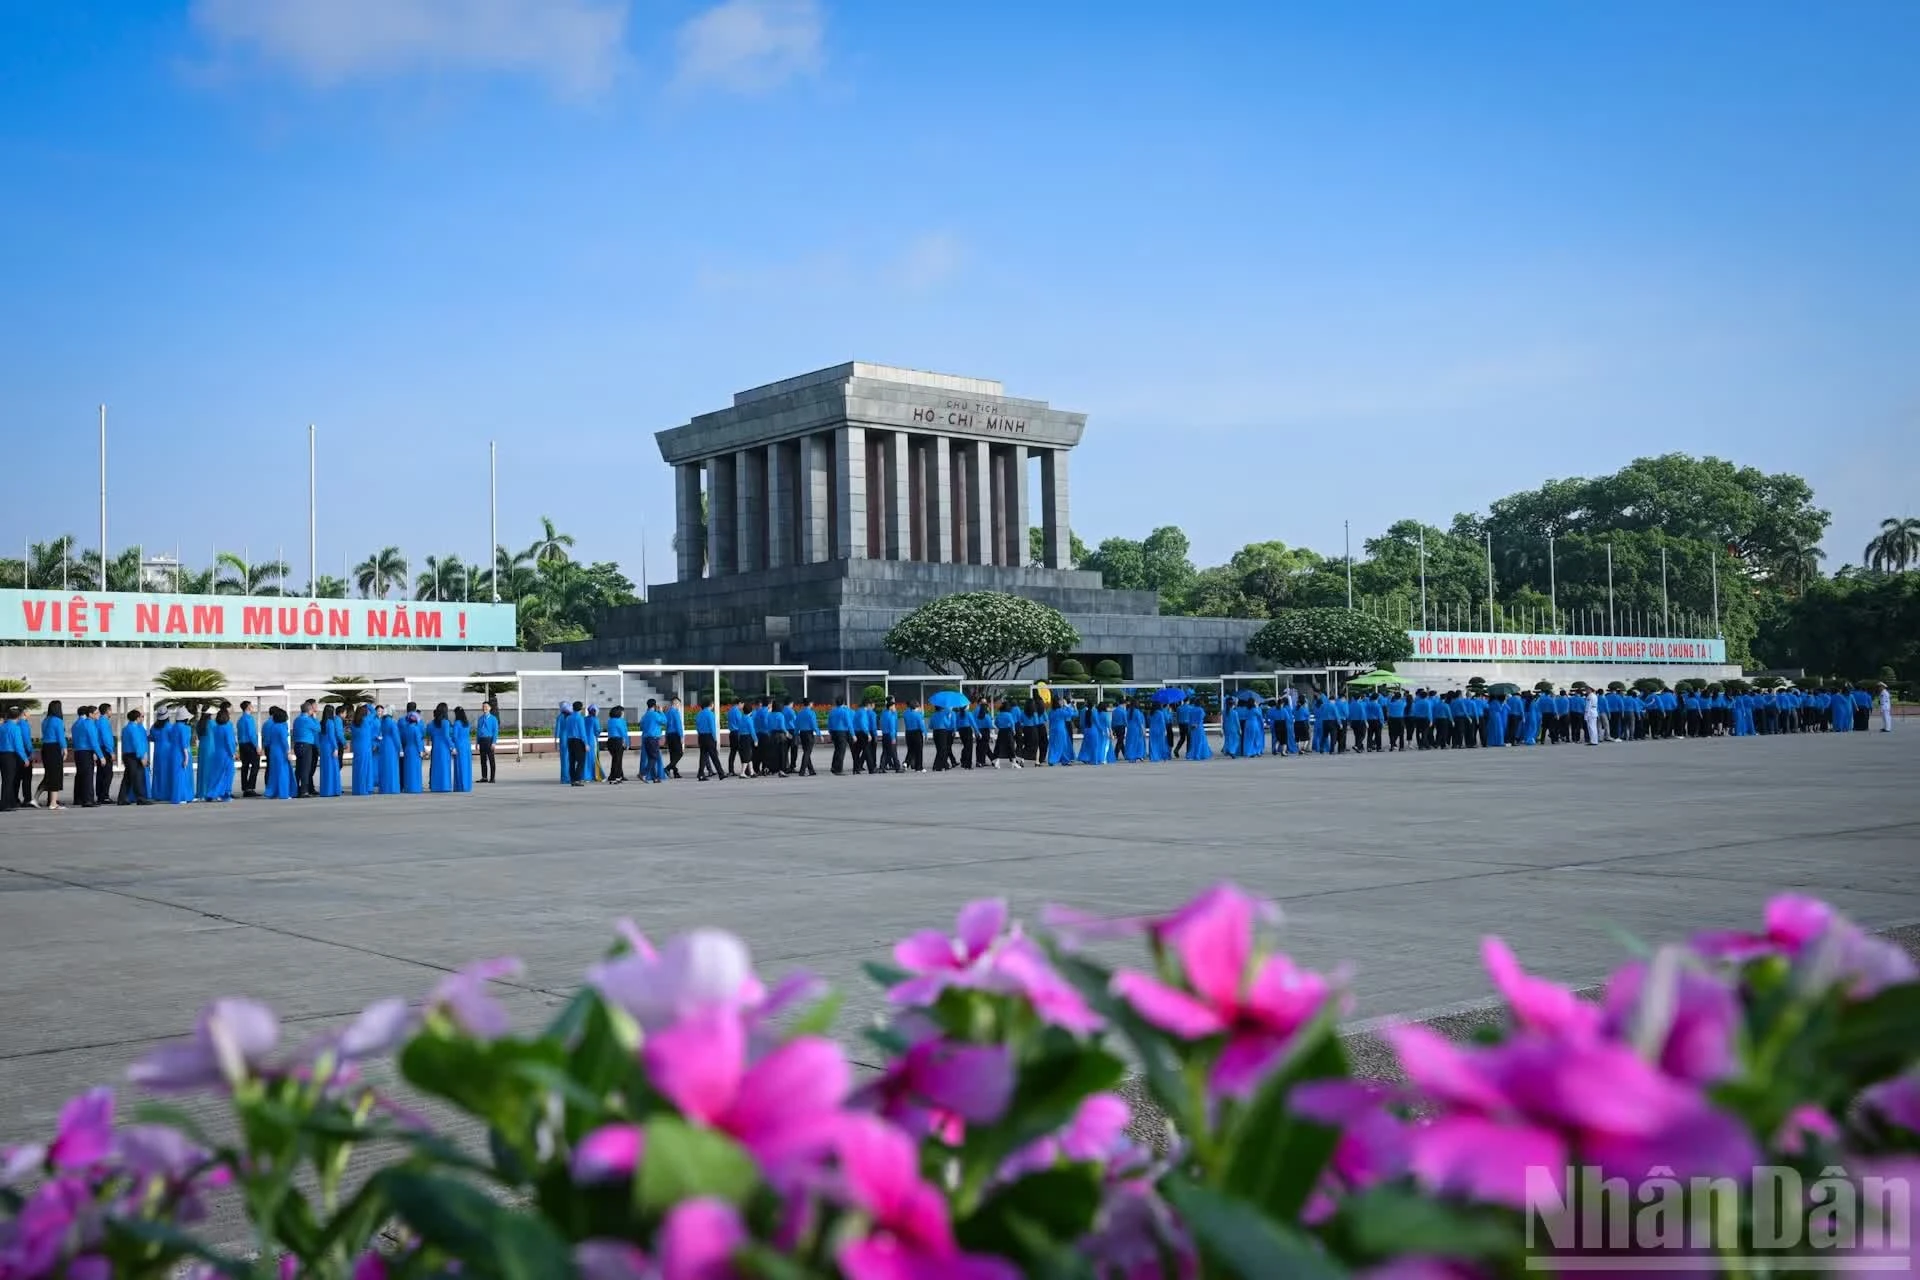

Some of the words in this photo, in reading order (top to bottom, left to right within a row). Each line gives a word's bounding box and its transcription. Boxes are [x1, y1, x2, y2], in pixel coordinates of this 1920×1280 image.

[986, 416, 1025, 432] MINH
[23, 595, 115, 638] VIỆT
[136, 604, 224, 634] NAM
[242, 602, 349, 636] MUÔN
[368, 604, 442, 638] NĂM
[1458, 637, 1485, 655] MINH
[1570, 640, 1599, 657] TRONG
